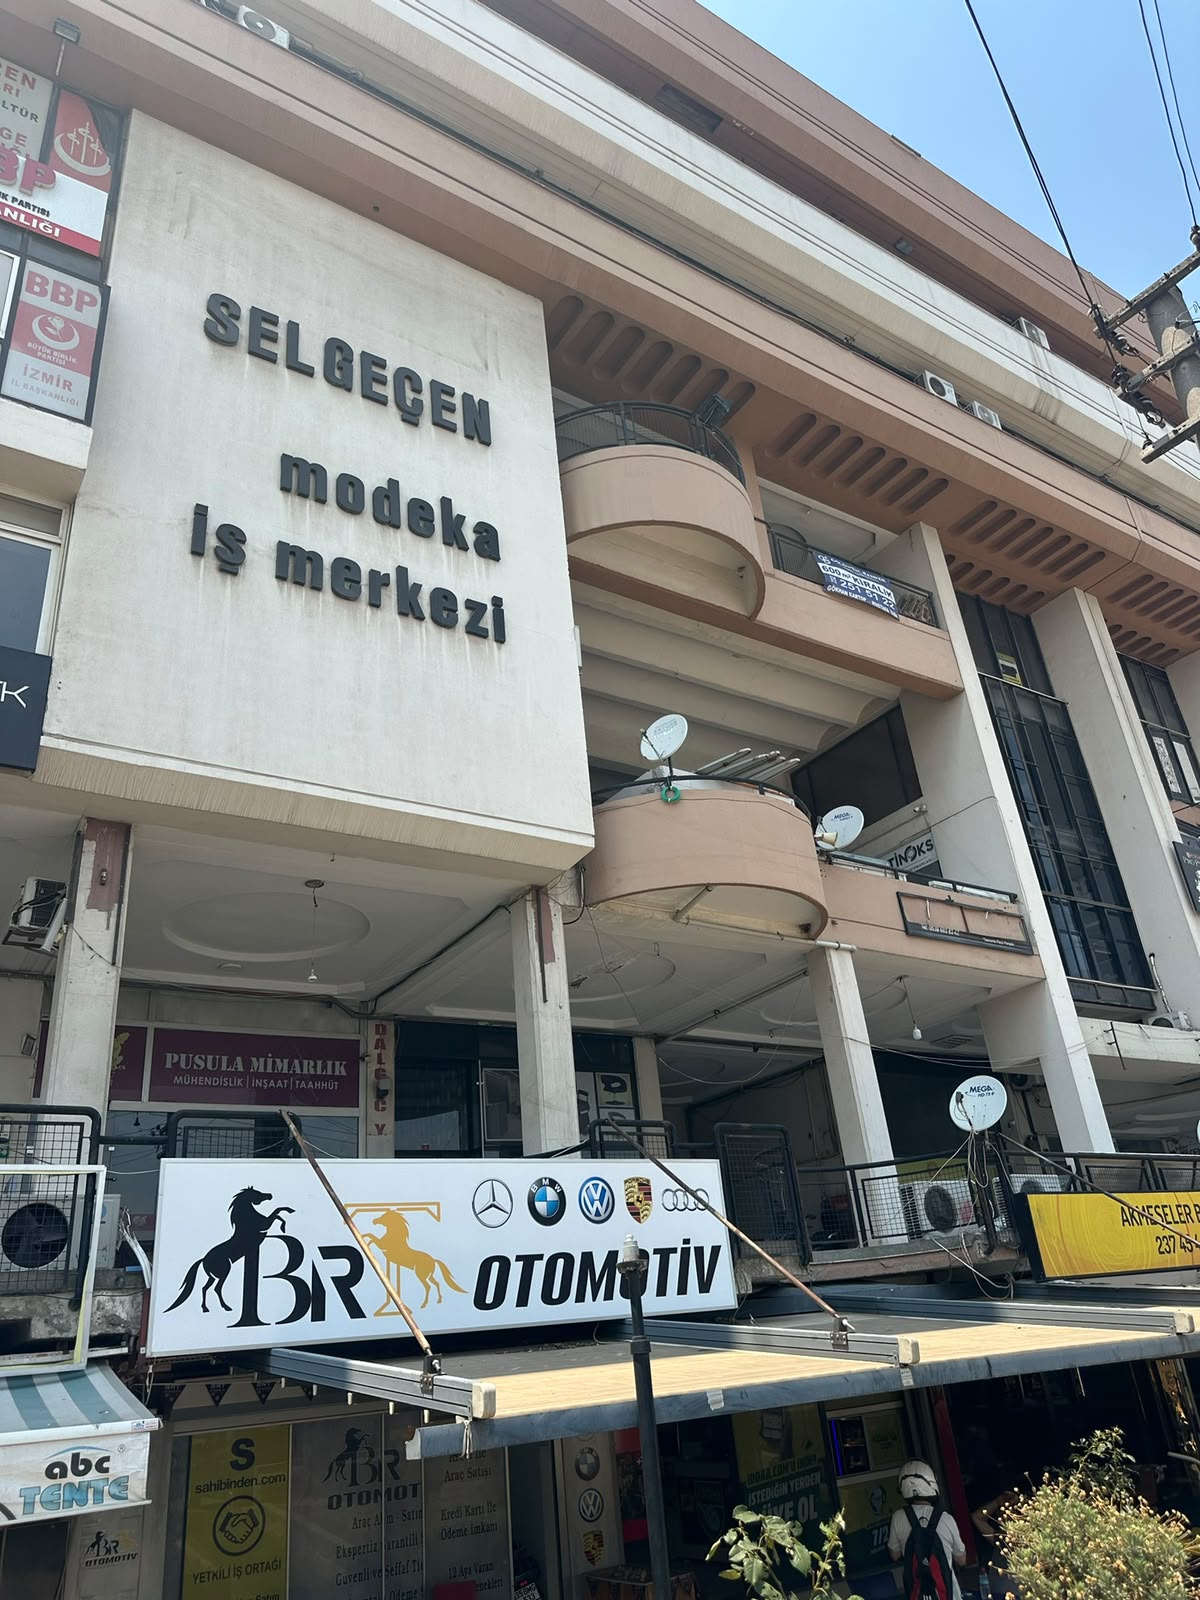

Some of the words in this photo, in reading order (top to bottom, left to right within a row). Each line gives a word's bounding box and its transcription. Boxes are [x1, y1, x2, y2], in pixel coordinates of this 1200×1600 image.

[0, 62, 37, 91] EN
[0, 83, 20, 97] RI
[25, 270, 98, 313] BBP
[26, 340, 52, 355] BÜYÜK
[52, 350, 78, 365] BİRLİK
[22, 362, 74, 393] İZMİR
[204, 292, 492, 447] SELGEÇEN
[22, 380, 80, 408] BAŞKANLIĞI
[279, 452, 502, 563] modeka
[822, 565, 842, 576] 600
[275, 540, 507, 645] merkezi
[839, 579, 862, 595] 251
[165, 1052, 245, 1073] PUSULA
[249, 1053, 348, 1077] MİMARLIK
[173, 1074, 244, 1088] MÜHENDİSLİK
[251, 1077, 289, 1090] İNŞAAT
[295, 1080, 339, 1091] TAAHHÜT
[969, 1084, 993, 1093] MEGA
[1120, 1204, 1195, 1231] AKMEŞELER
[1155, 1234, 1176, 1255] 237
[473, 1238, 722, 1311] OTOMOTİV
[45, 1452, 111, 1480] abc
[229, 1438, 256, 1471] S
[20, 1475, 130, 1515] TENTE
[195, 1472, 287, 1494] sahibinden.com
[788, 1471, 821, 1493] YERDEN
[440, 1505, 463, 1521] Kredi
[464, 1503, 485, 1518] Kartı
[336, 1540, 378, 1560] Ekspertiz
[381, 1531, 418, 1551] arantili
[192, 1565, 231, 1585] YETKİLİ
[244, 1556, 282, 1576] ORTAĞI
[473, 1559, 494, 1575] Varan
